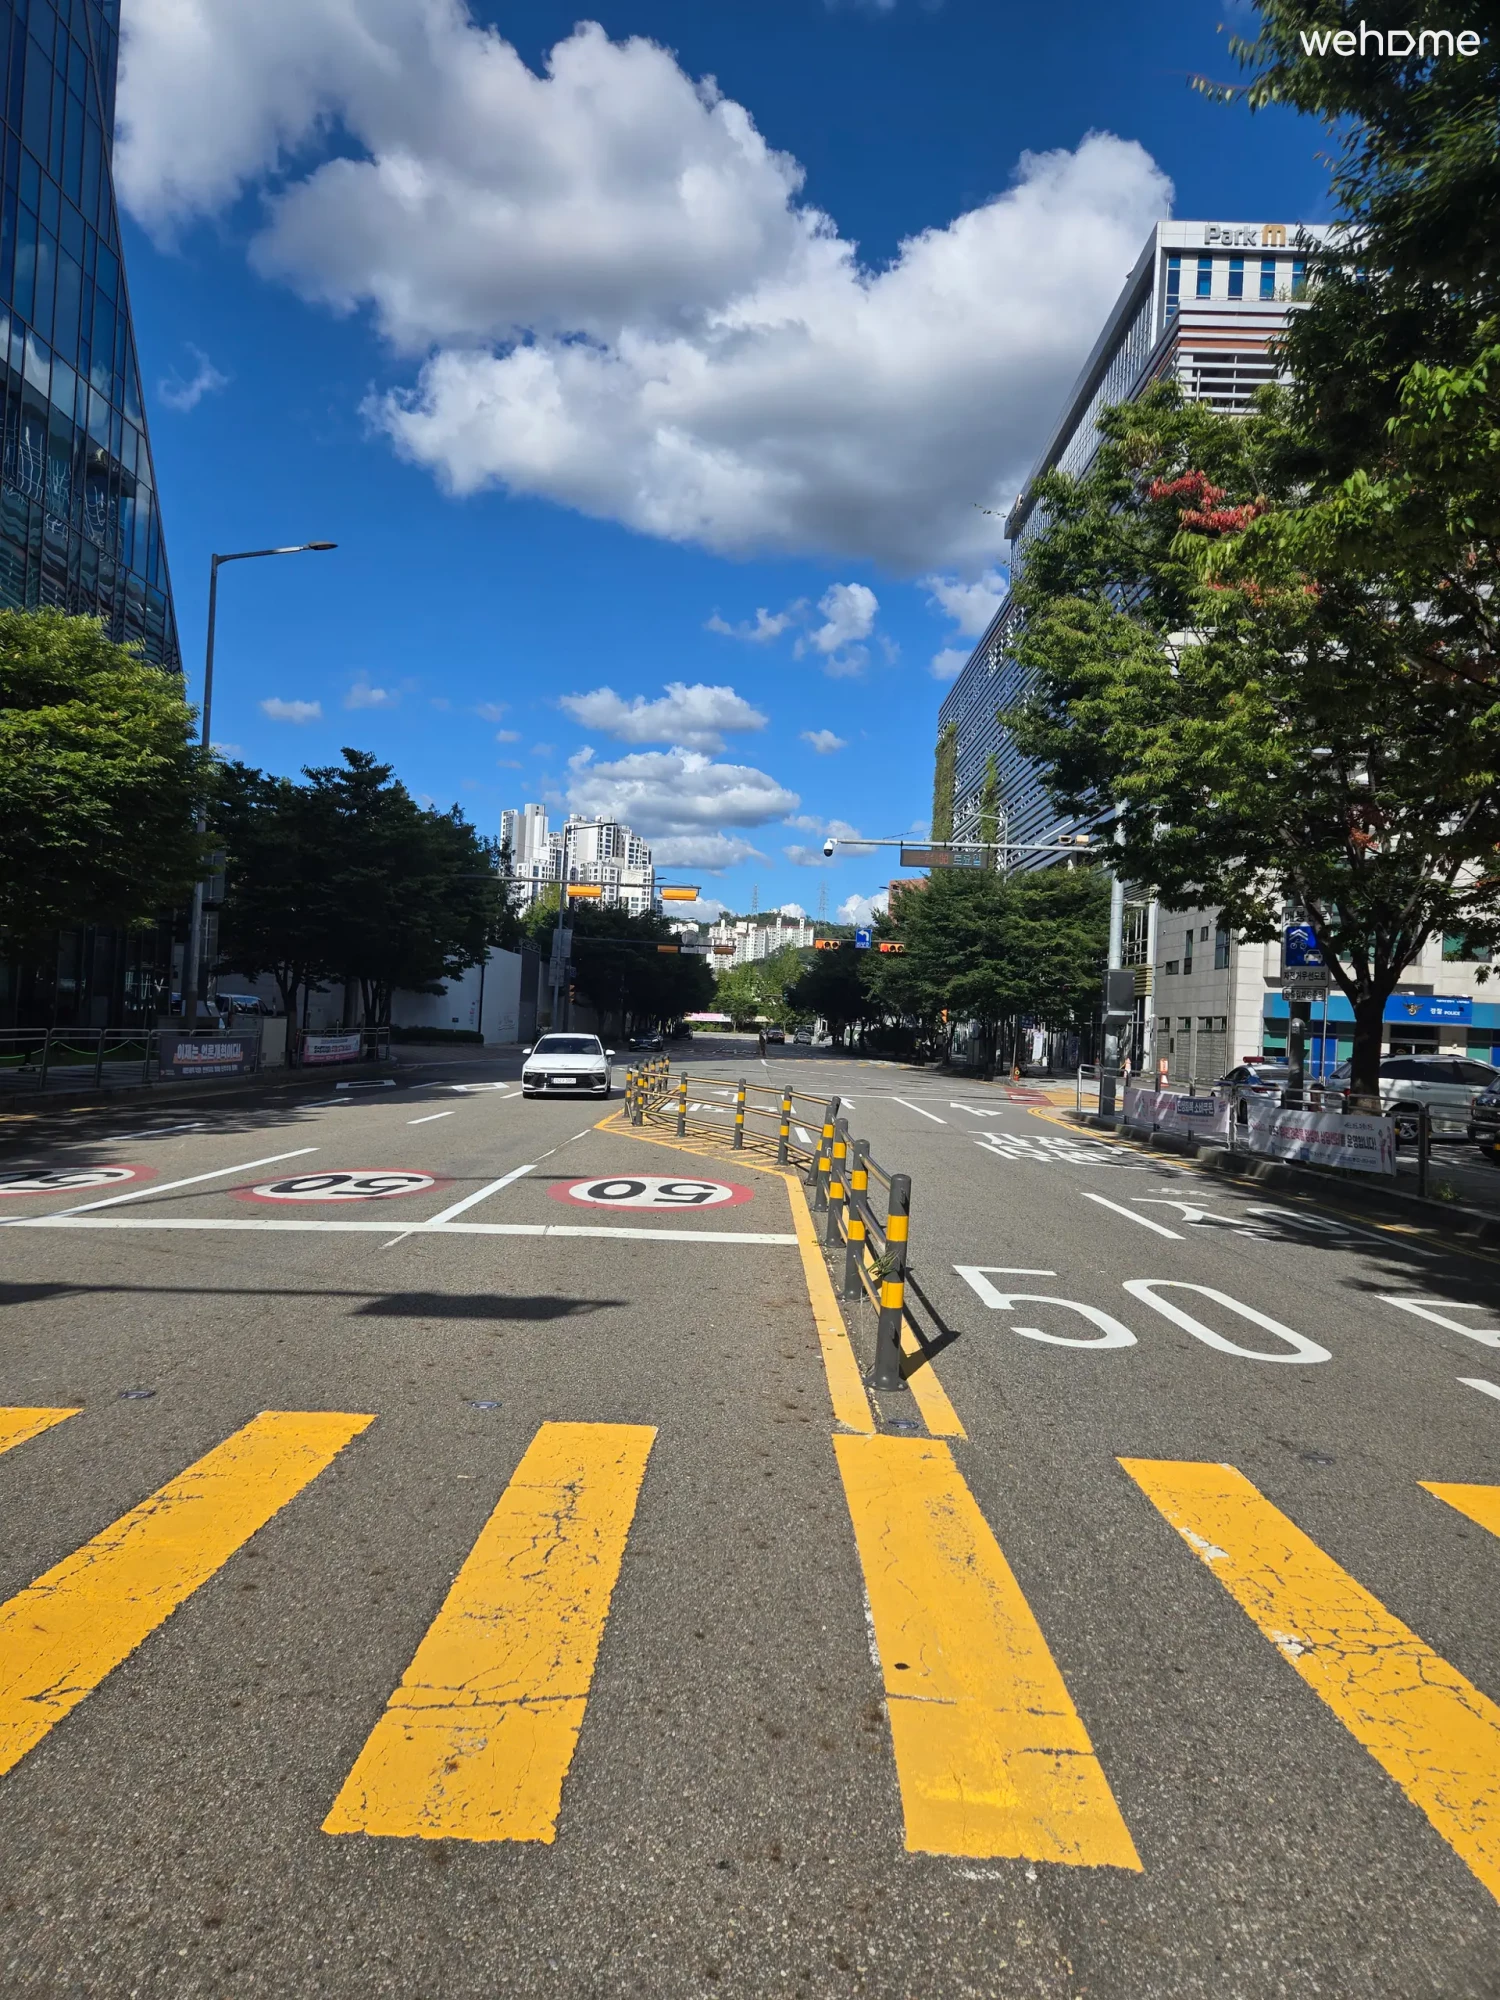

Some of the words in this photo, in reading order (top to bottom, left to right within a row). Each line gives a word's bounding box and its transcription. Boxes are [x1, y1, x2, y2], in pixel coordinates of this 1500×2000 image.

[1205, 225, 1257, 246] Park
[1283, 971, 1326, 981] 자전거우선도로
[177, 1044, 199, 1060] 이제는
[1347, 1134, 1377, 1151] 운영합니다!
[270, 1174, 424, 1196] 50
[587, 1180, 718, 1204] 50
[952, 1264, 1332, 1364] 50
